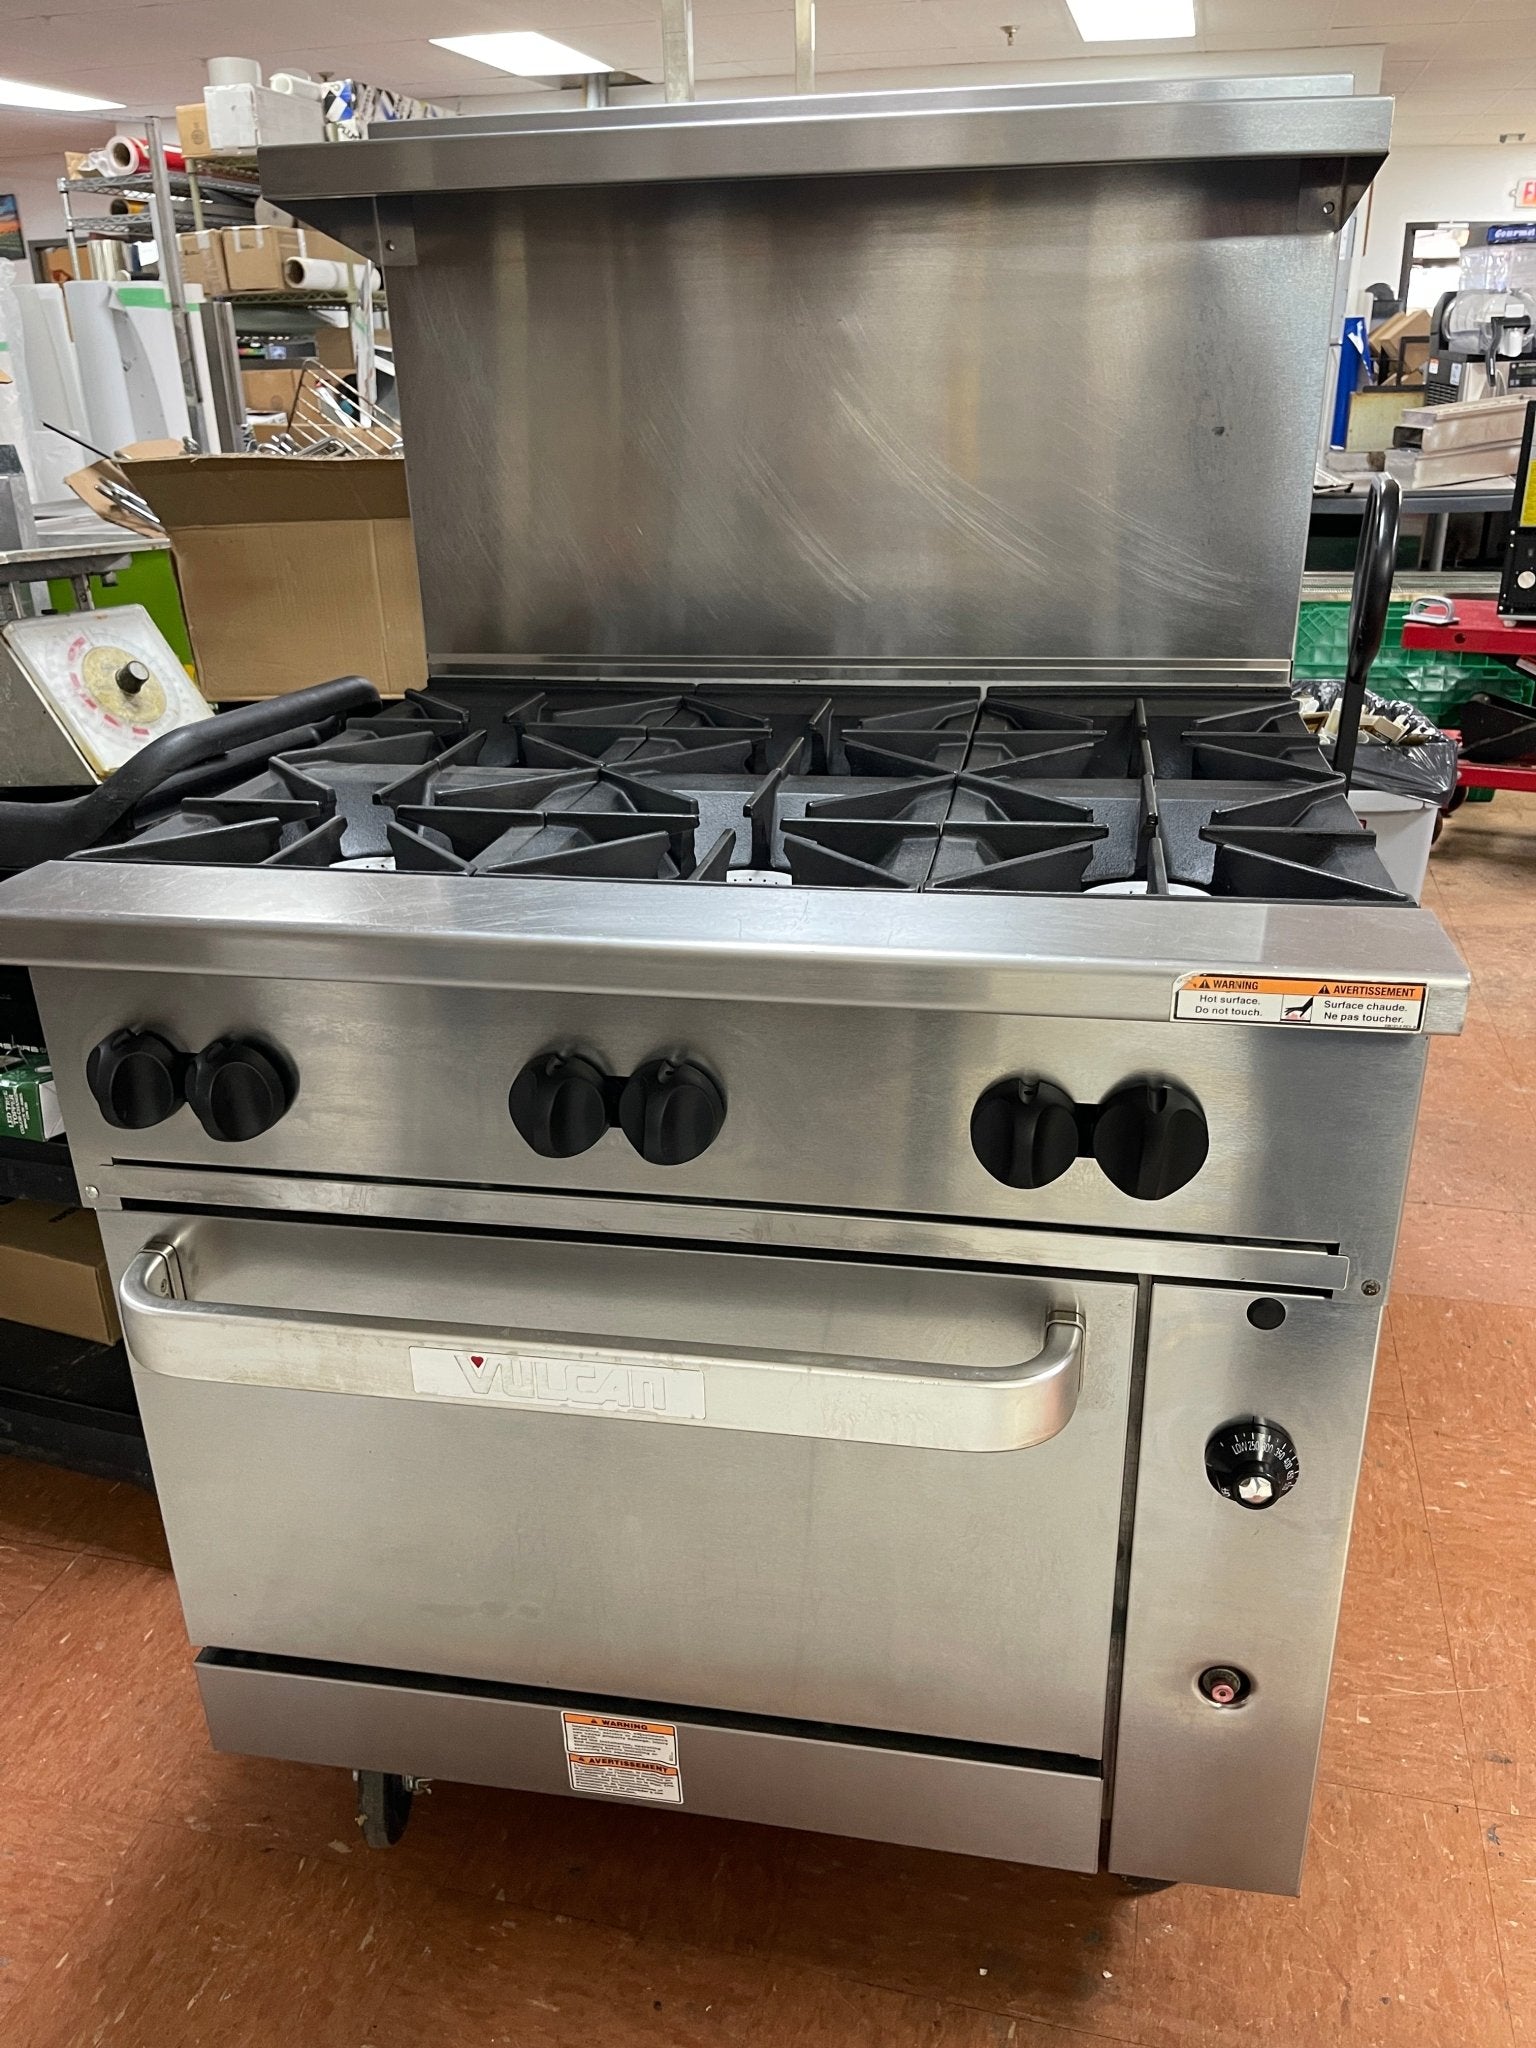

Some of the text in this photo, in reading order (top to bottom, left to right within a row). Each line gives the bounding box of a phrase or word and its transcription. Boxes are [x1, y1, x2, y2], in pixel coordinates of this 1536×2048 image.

[1213, 979, 1258, 990] WARNING
[1333, 985, 1416, 997] AVERTISSEMENT
[1199, 994, 1261, 1005] Hot surface.
[1195, 1005, 1263, 1017] Do not touch.
[1324, 1000, 1408, 1012] Surface chaude.
[1324, 1012, 1404, 1024] Ne pas toucher.
[454, 1353, 666, 1410] VULCAN
[1231, 1441, 1248, 1455] LOW
[1248, 1440, 1260, 1451] 250
[1273, 1447, 1286, 1460] 350
[602, 1719, 648, 1731] WARNING
[589, 1757, 668, 1774] AVERTISSEMENT
